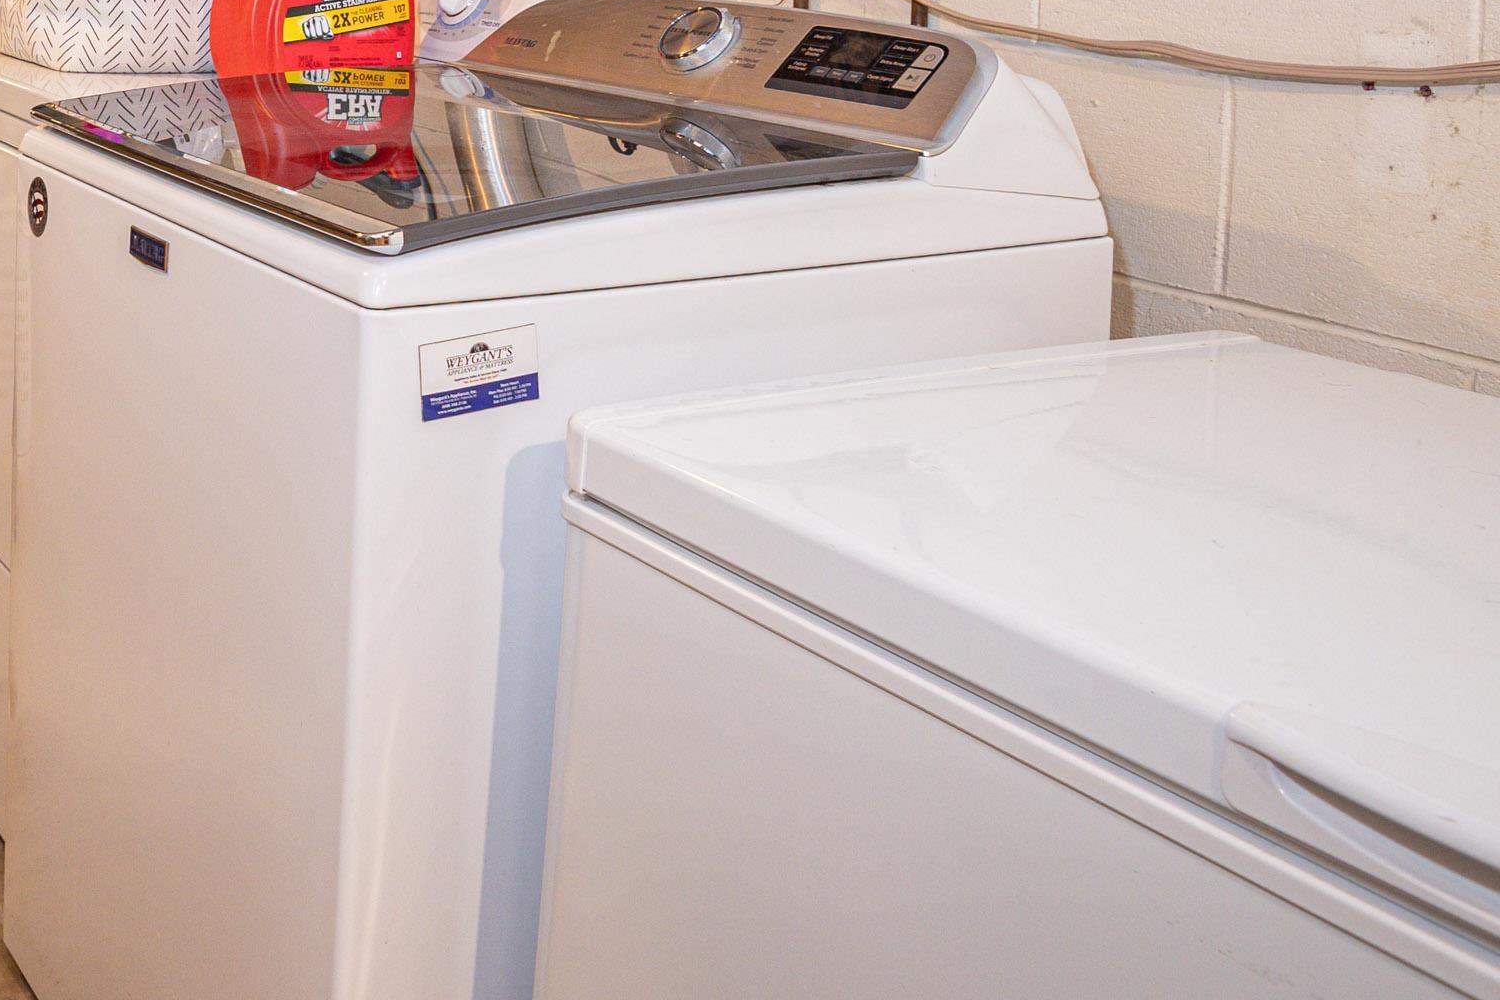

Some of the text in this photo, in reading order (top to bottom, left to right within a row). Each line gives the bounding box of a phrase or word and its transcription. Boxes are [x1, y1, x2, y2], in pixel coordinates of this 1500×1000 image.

[314, 1, 342, 12] ACTIVE
[332, 11, 385, 29] 2X POWER
[446, 346, 513, 368] WEYGANT'S
